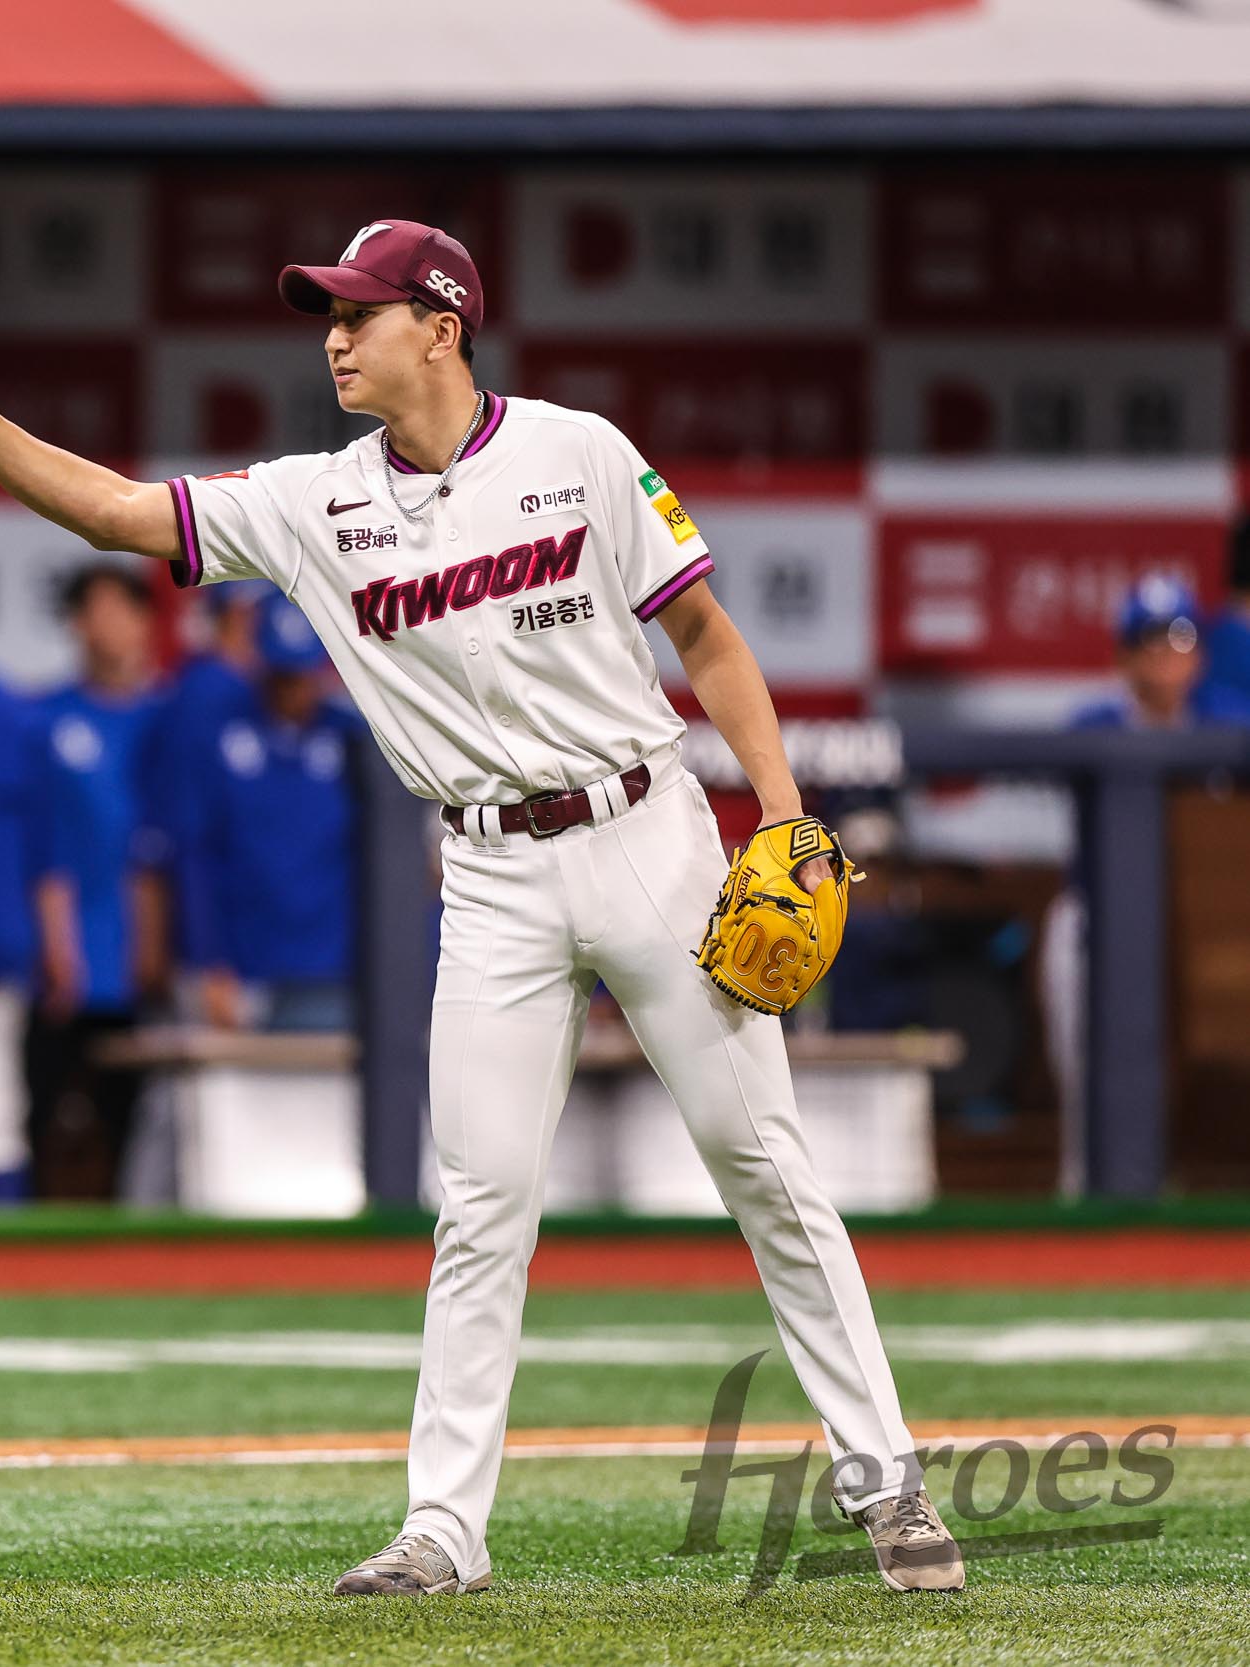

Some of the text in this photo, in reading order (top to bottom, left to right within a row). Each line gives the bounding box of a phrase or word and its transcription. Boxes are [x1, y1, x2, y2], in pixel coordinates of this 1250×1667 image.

[424, 269, 468, 307] SGC
[543, 485, 585, 507] 미래엔
[336, 527, 398, 552] 동광제약
[350, 524, 589, 642] KIWOOM
[512, 592, 594, 631] 키움증권
[733, 921, 800, 992] 30
